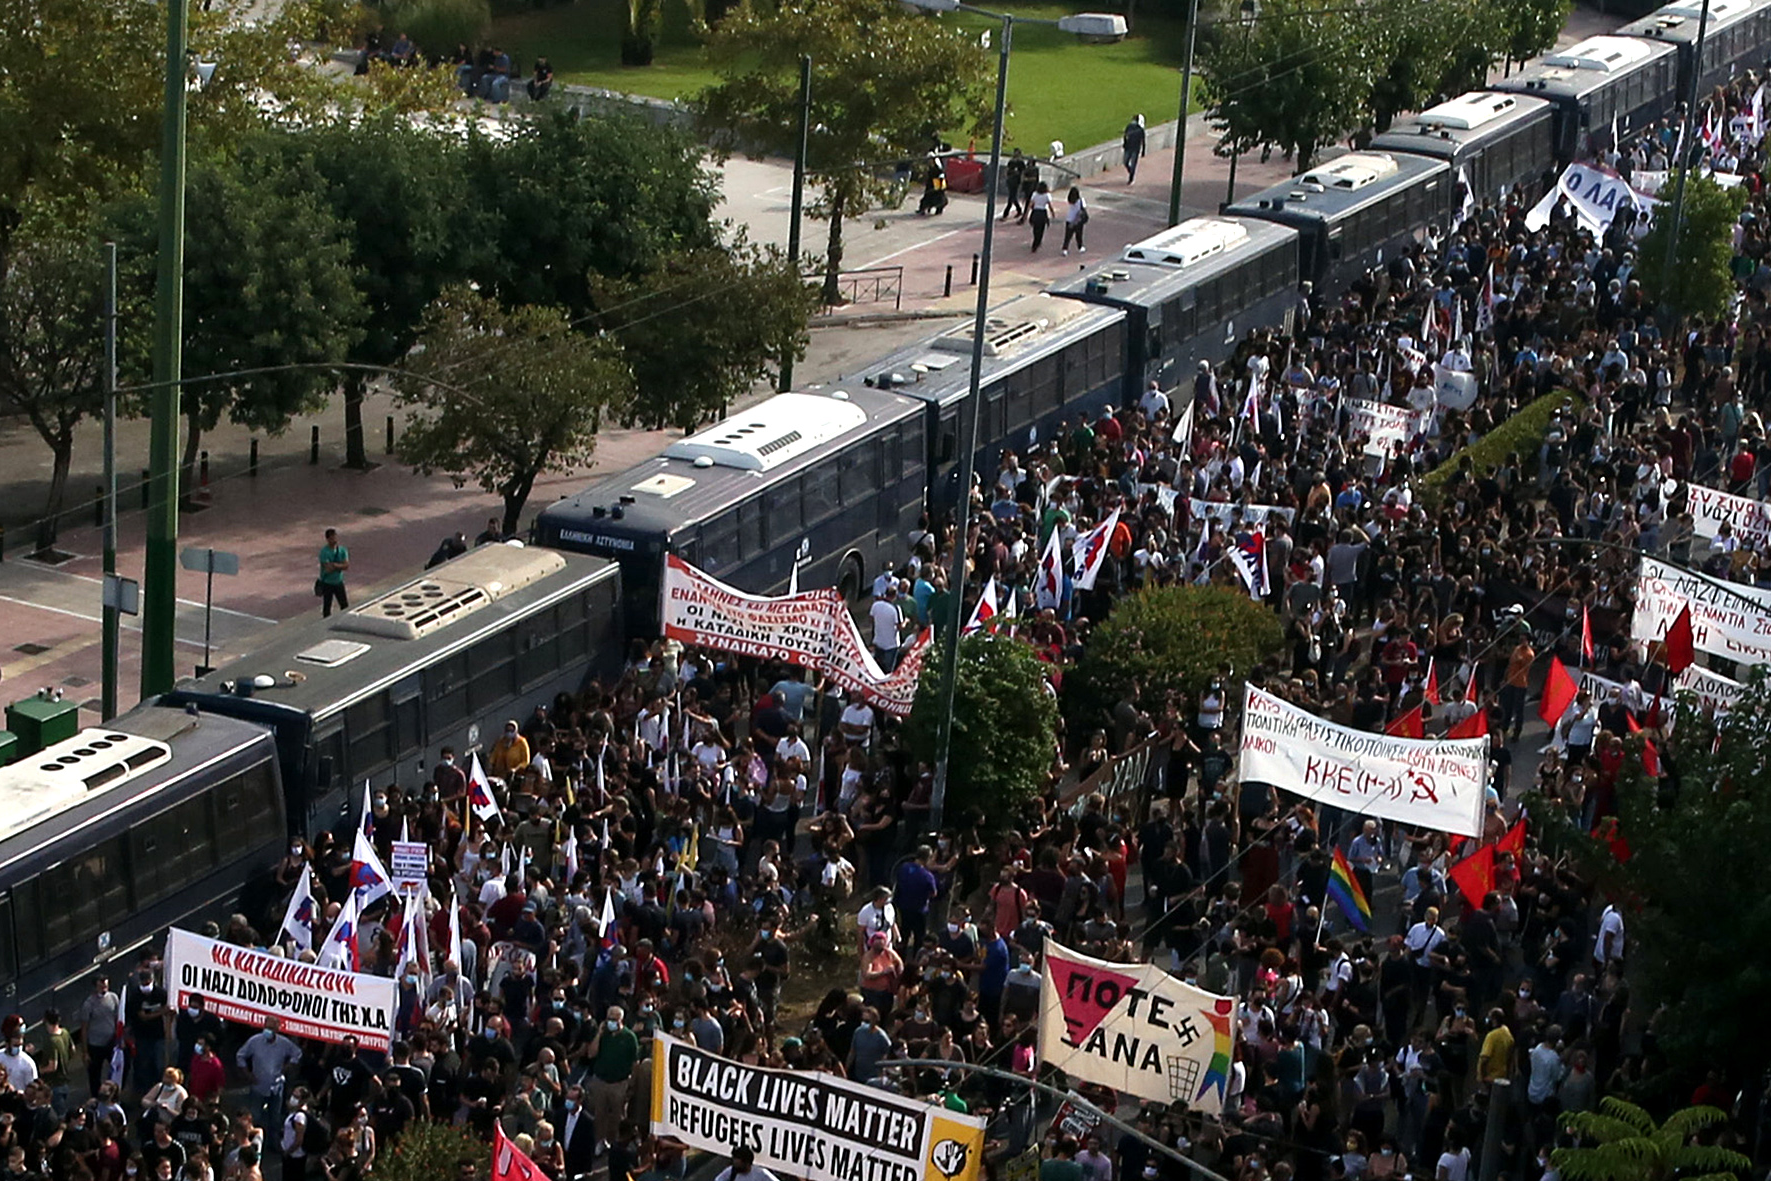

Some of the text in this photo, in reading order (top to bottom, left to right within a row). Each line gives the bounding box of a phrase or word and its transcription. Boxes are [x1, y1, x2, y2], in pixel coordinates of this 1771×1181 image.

[687, 604, 704, 617] ΟΙ
[694, 632, 790, 662] ΣΥΝΔΙΚΑΤΟ
[181, 963, 390, 1031] ΟΙ ΝΑΖΙ ΔΟΛΟΦΟΝΟΙ ΤΗΣ Χ.Α.
[211, 943, 357, 996] ΝΑ ΚΑΤΑΔΙΚΑΣΤΟΥΝ
[1065, 970, 1174, 1030] ΠΟΤΕ
[1060, 1014, 1163, 1075] ΞΑΝΑ
[669, 1095, 764, 1155] REFUGEES
[769, 1126, 827, 1170] LIVES
[676, 1054, 919, 1152] BLACK LIVES MATTER
